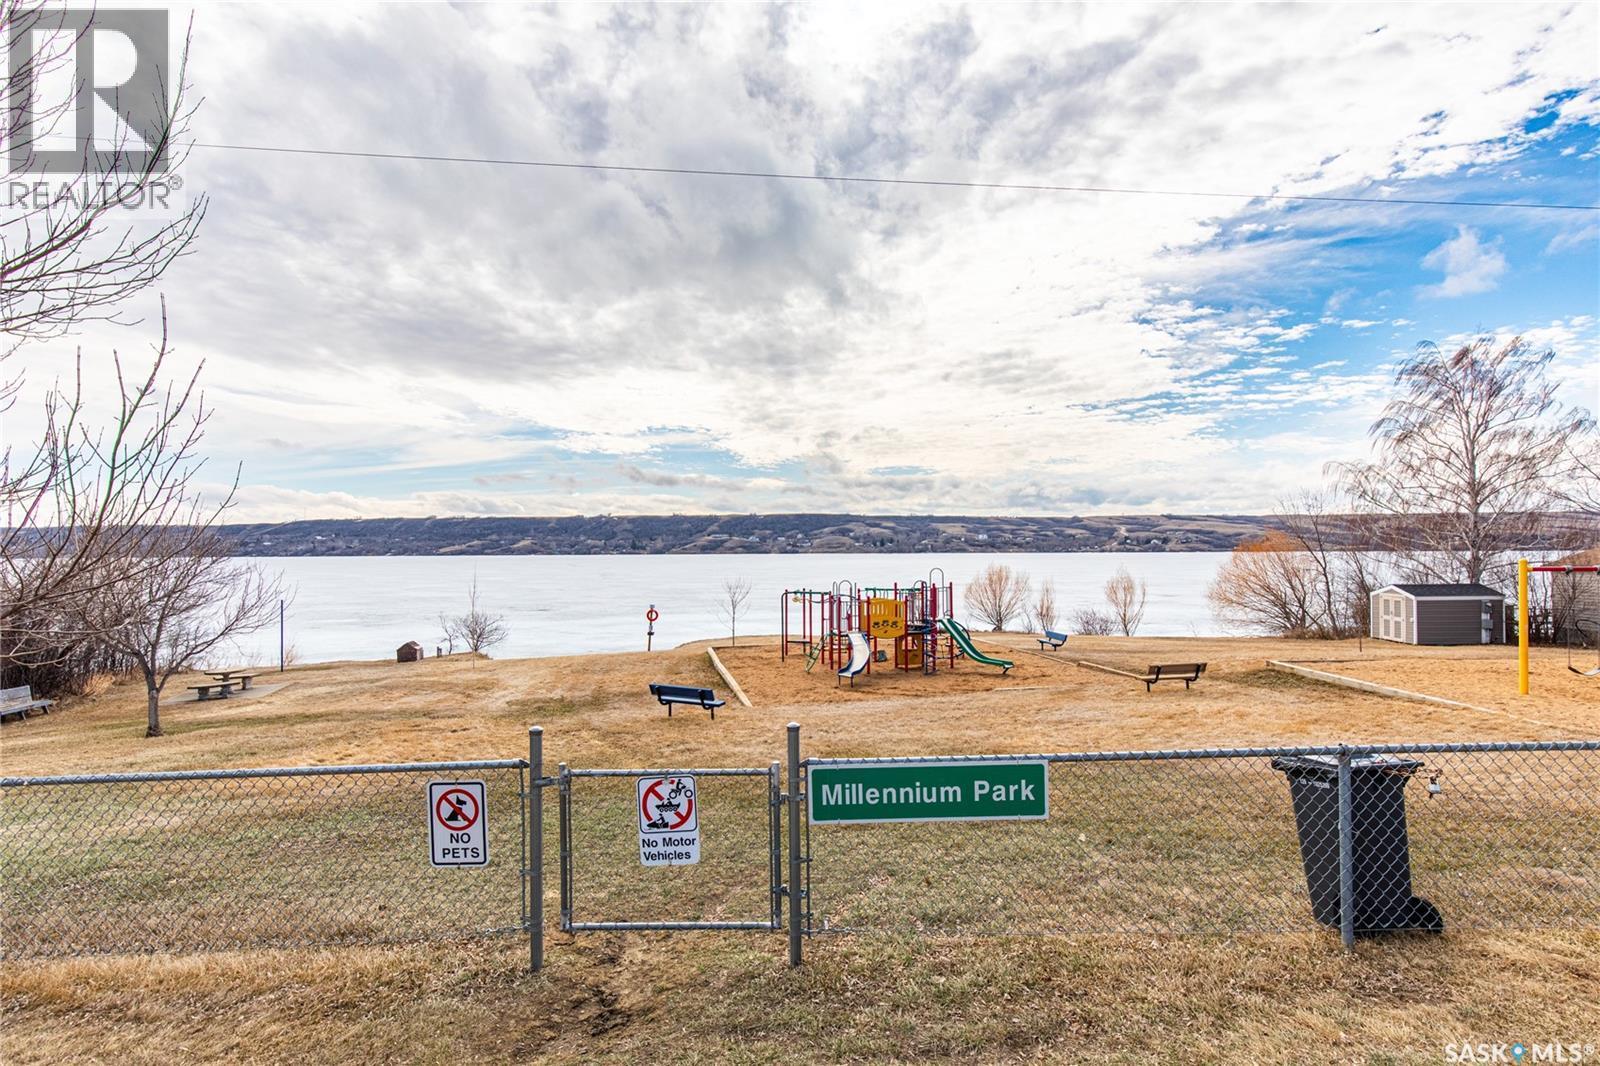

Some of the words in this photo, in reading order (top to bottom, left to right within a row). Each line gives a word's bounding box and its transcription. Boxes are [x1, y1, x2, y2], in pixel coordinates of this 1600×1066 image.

[821, 782, 962, 806] Millennium
[973, 779, 1036, 802] Park
[449, 832, 471, 844] NO
[641, 838, 658, 848] No
[662, 836, 697, 847] Motor
[442, 847, 480, 859] PETS
[643, 850, 692, 861] Vehicles
